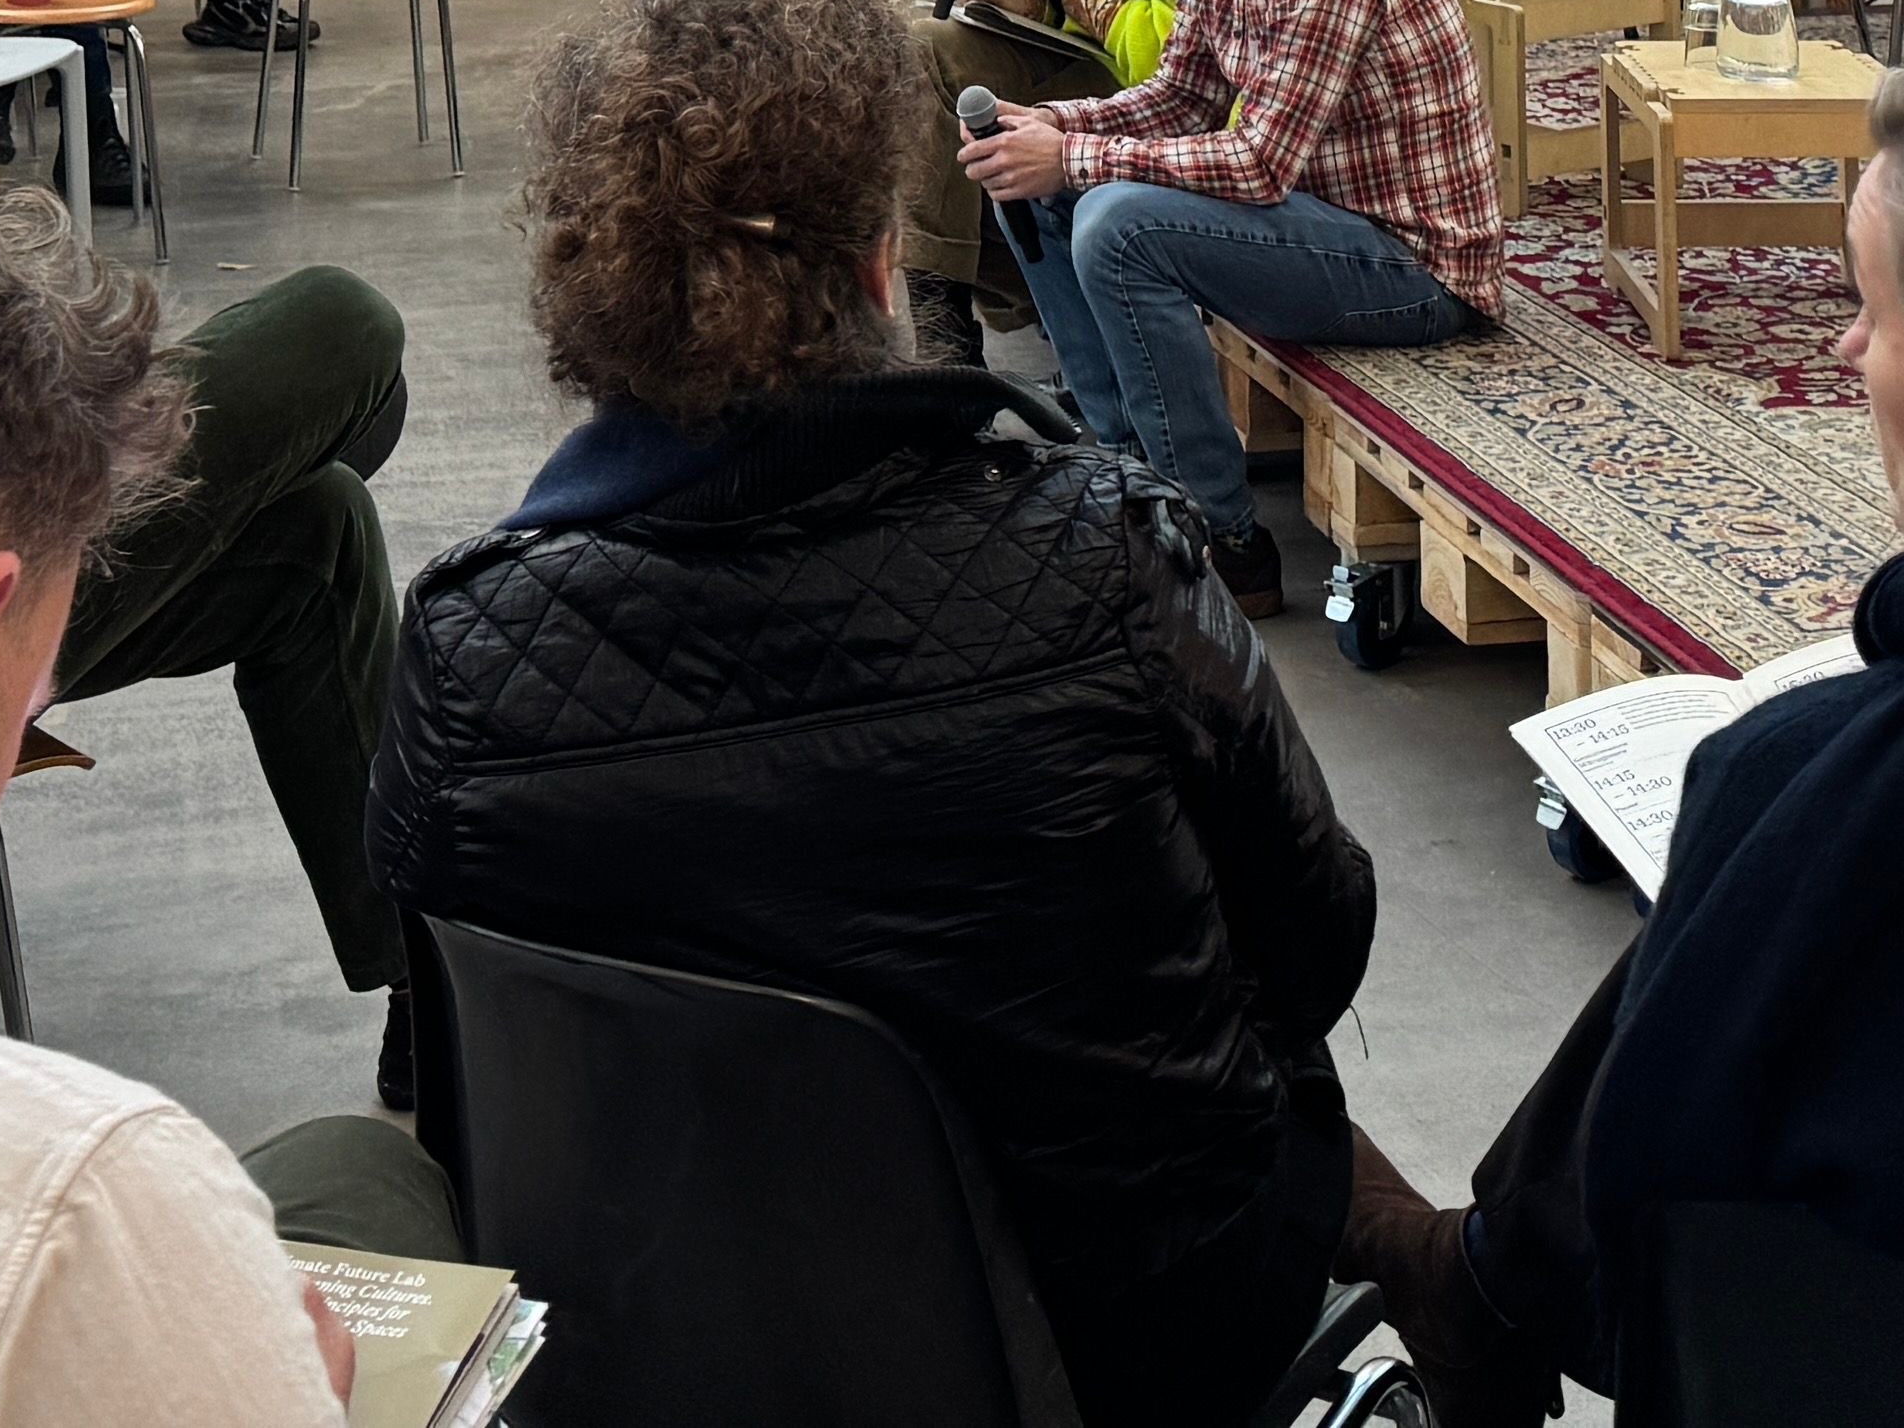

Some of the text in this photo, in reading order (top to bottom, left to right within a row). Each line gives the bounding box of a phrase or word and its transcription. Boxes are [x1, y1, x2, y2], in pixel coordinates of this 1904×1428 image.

[333, 1262, 390, 1282] Future
[393, 1271, 426, 1287] Lab
[377, 1305, 412, 1321] for
[350, 1319, 409, 1338] Spaces
